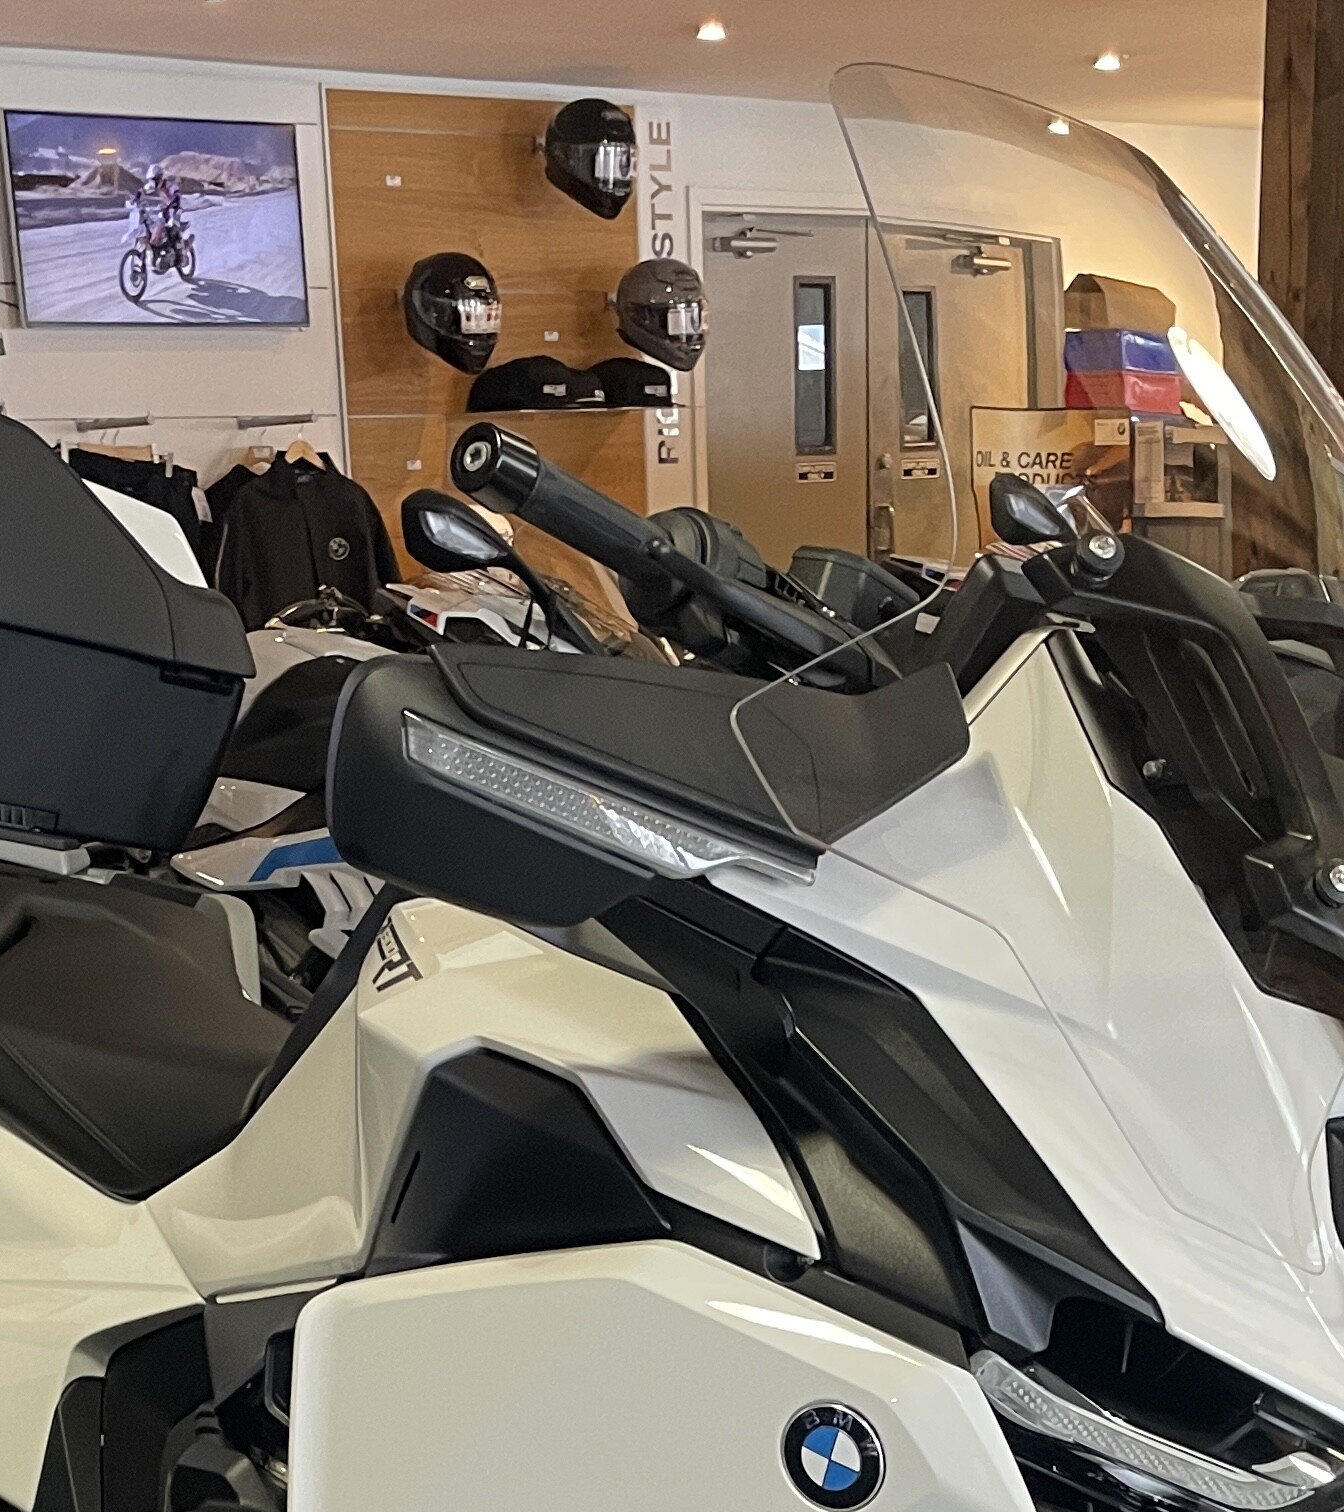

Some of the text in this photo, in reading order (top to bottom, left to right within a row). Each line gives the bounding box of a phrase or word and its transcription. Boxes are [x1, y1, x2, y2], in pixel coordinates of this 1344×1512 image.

[648, 121, 673, 258] STYLE
[976, 451, 1073, 470] OIL & CARE
